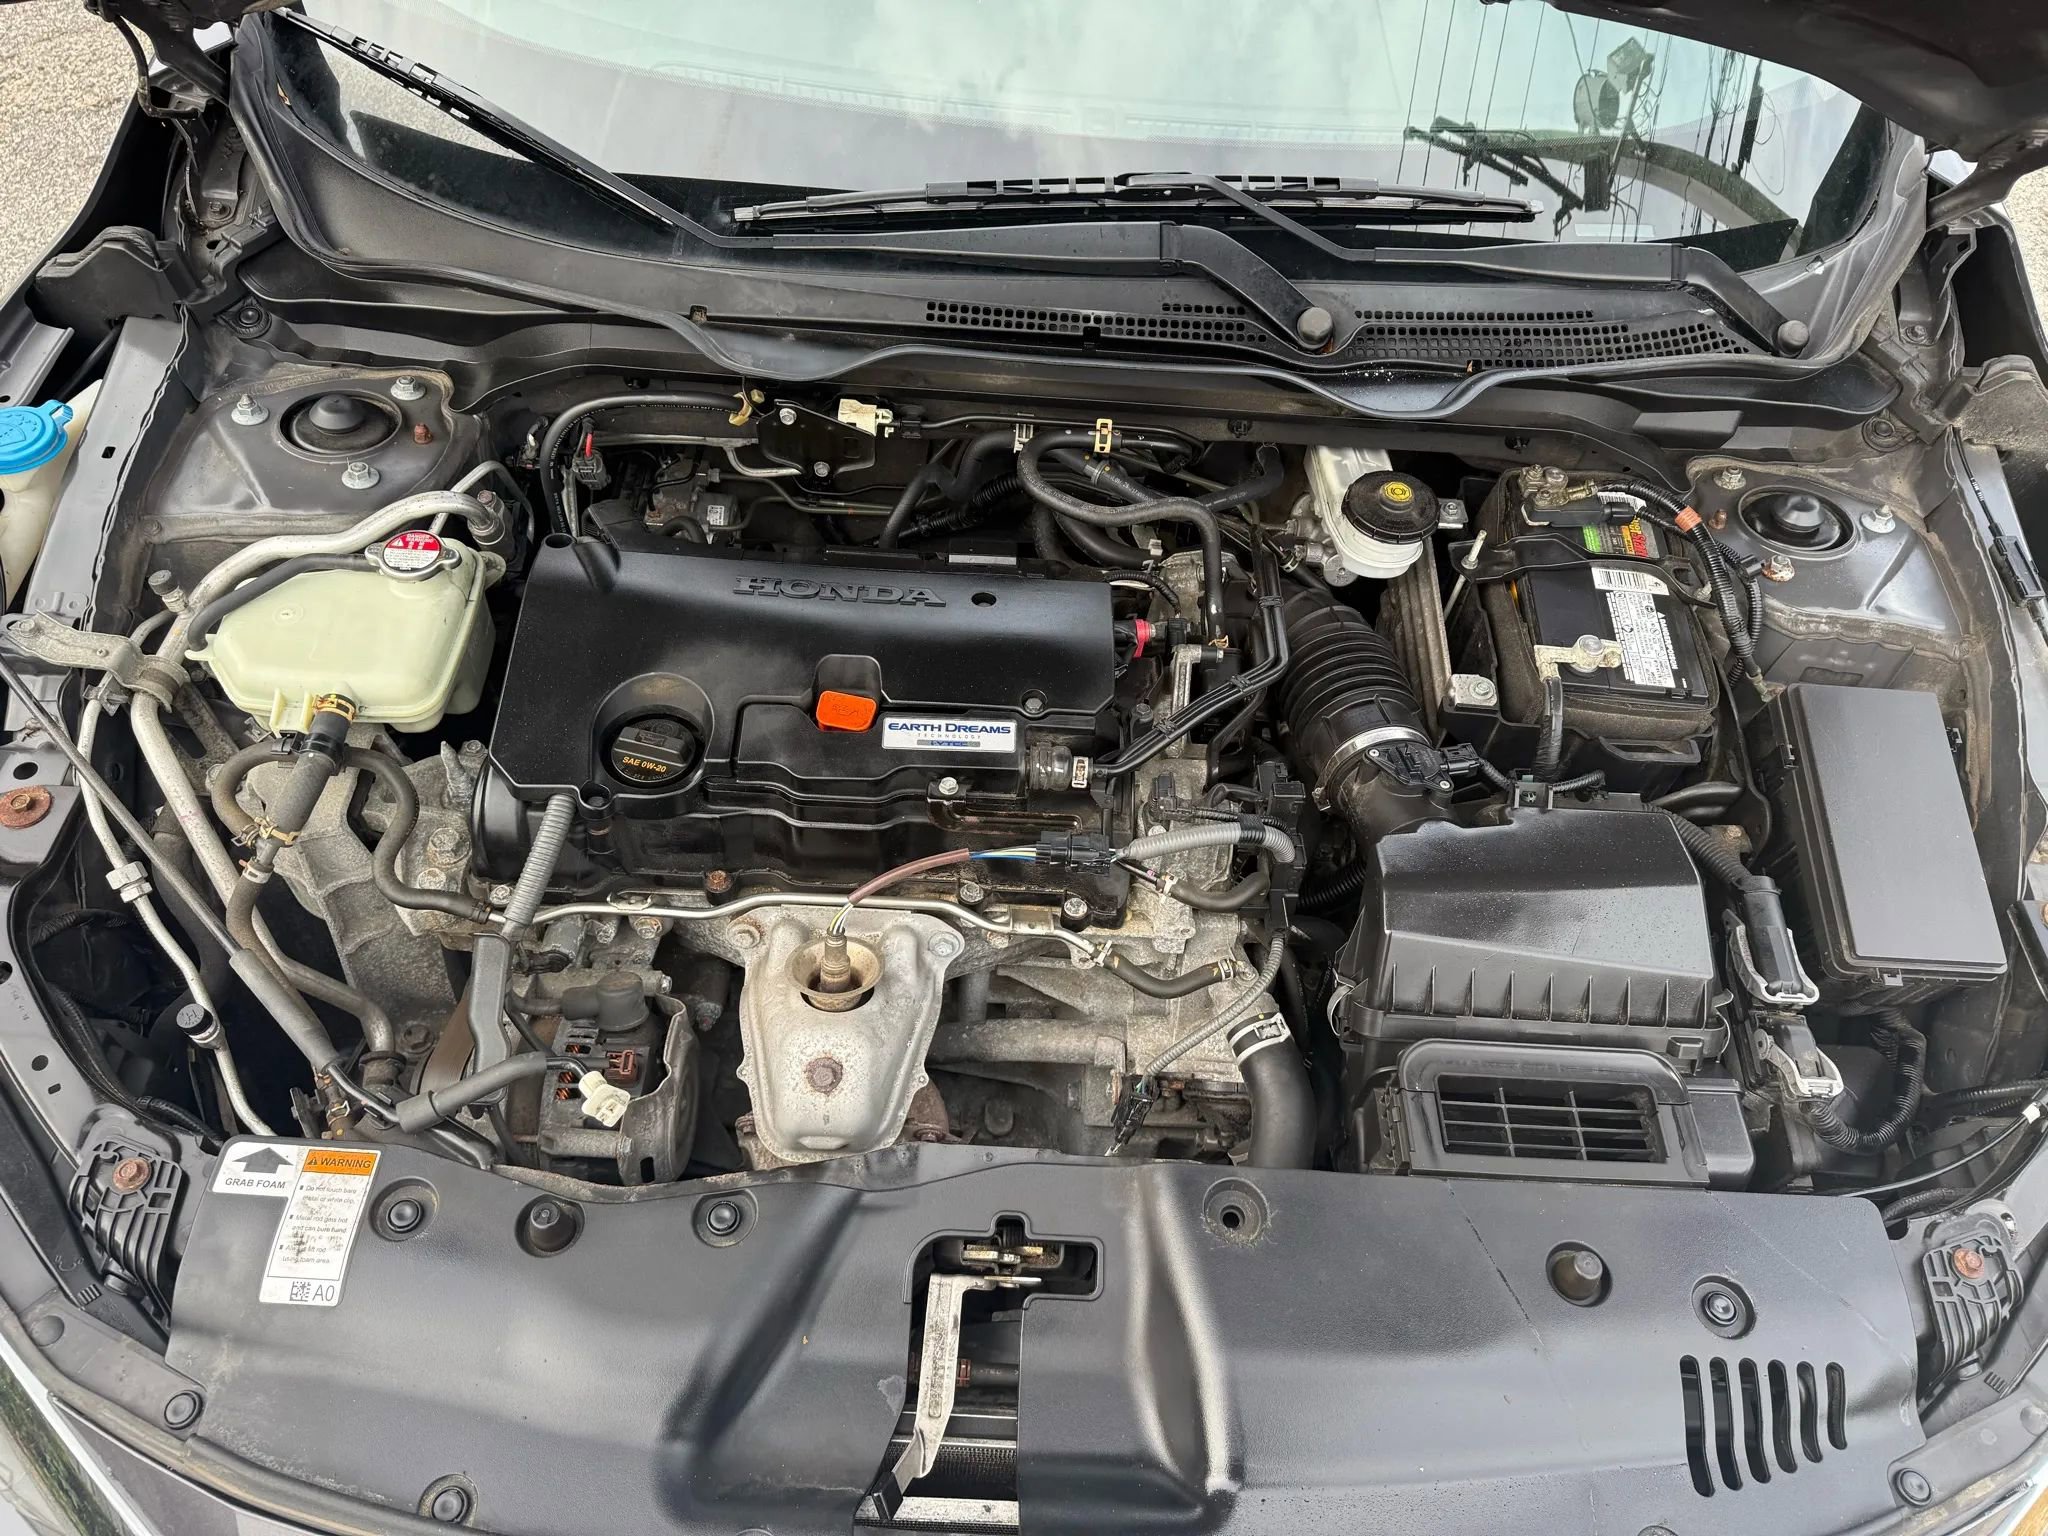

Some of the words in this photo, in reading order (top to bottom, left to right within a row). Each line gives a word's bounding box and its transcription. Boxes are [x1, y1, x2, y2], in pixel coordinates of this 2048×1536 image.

[733, 576, 947, 607] HONDA
[888, 722, 942, 732] EARTH
[945, 723, 1011, 734] DREAMS
[622, 756, 641, 766] SAE
[641, 761, 667, 773] 0W-20
[320, 1157, 371, 1169] WARNING
[225, 1177, 254, 1187] GRAB
[256, 1179, 286, 1189] FOAM
[312, 1284, 335, 1301] A0
